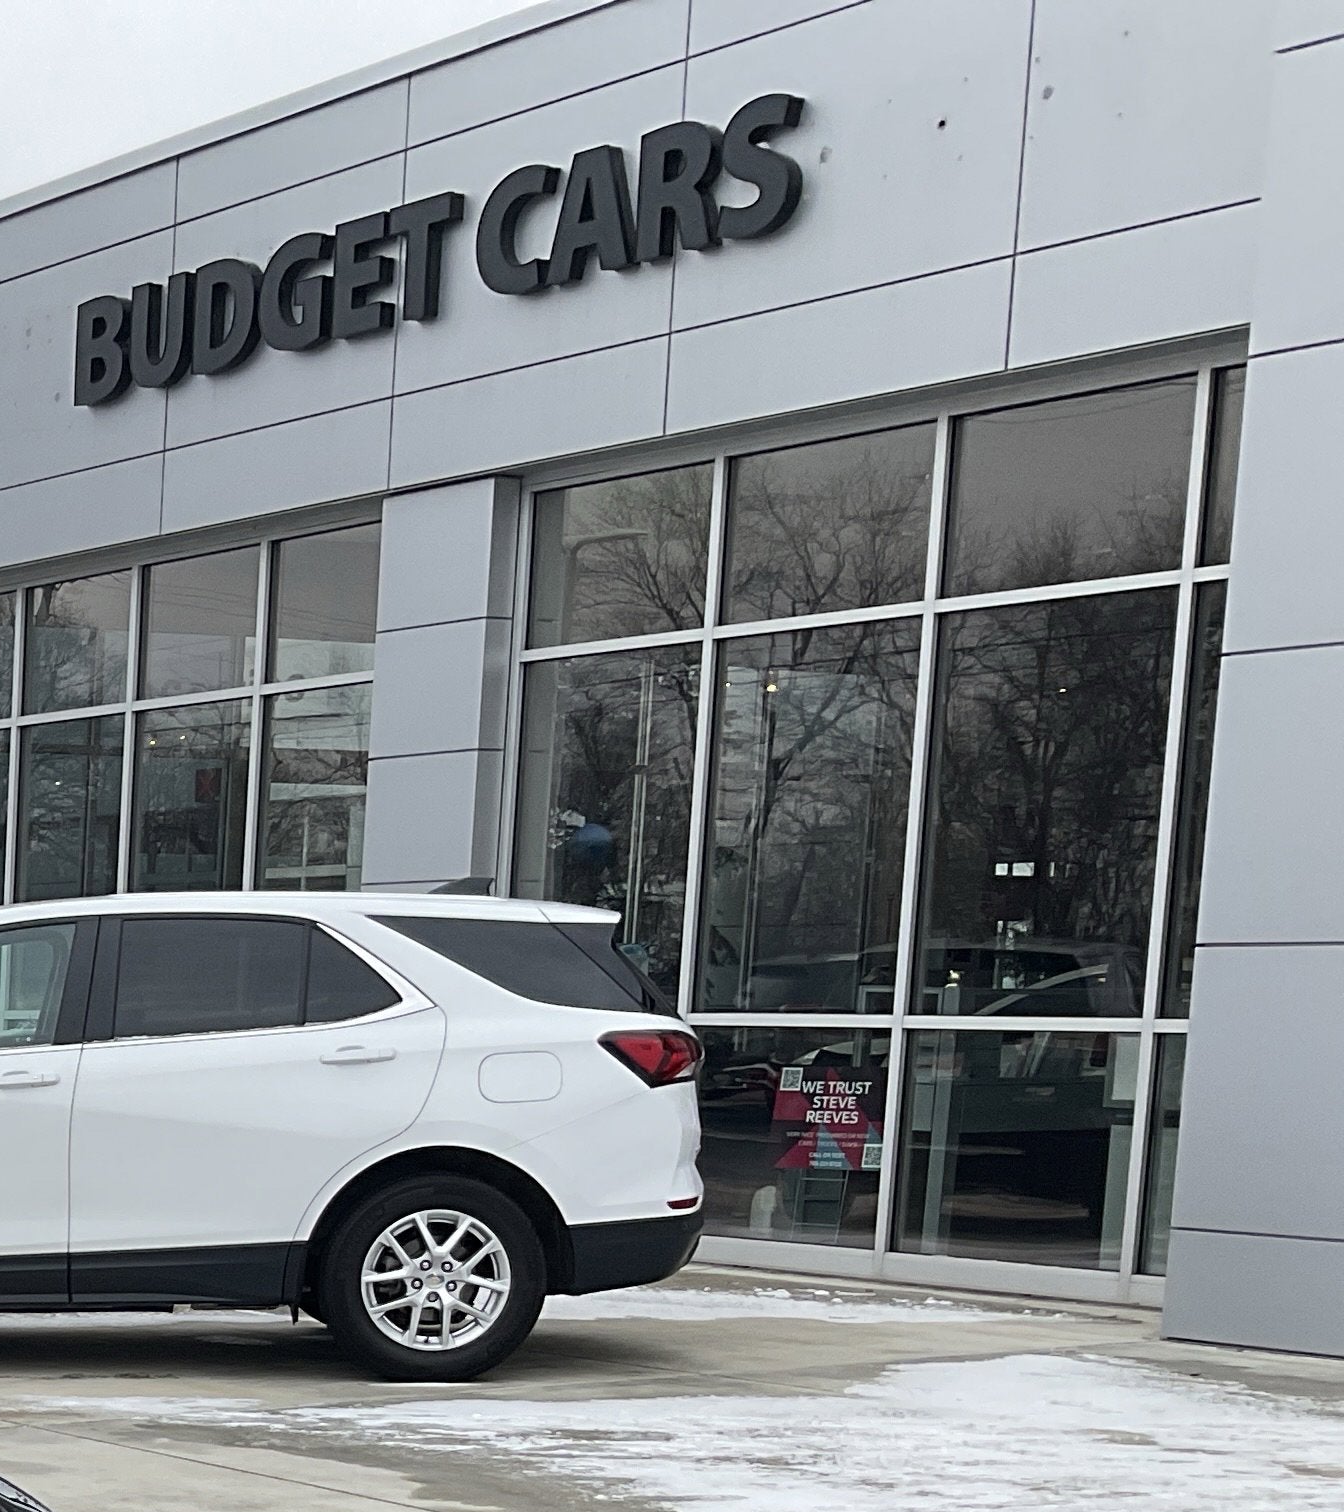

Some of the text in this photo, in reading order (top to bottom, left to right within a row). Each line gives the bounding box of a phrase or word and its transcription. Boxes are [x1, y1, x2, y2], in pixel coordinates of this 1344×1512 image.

[74, 93, 806, 406] BUDGET CARS
[802, 1080, 872, 1095] WE TRUST
[812, 1095, 857, 1109] STEVE
[805, 1110, 859, 1124] REEVES
